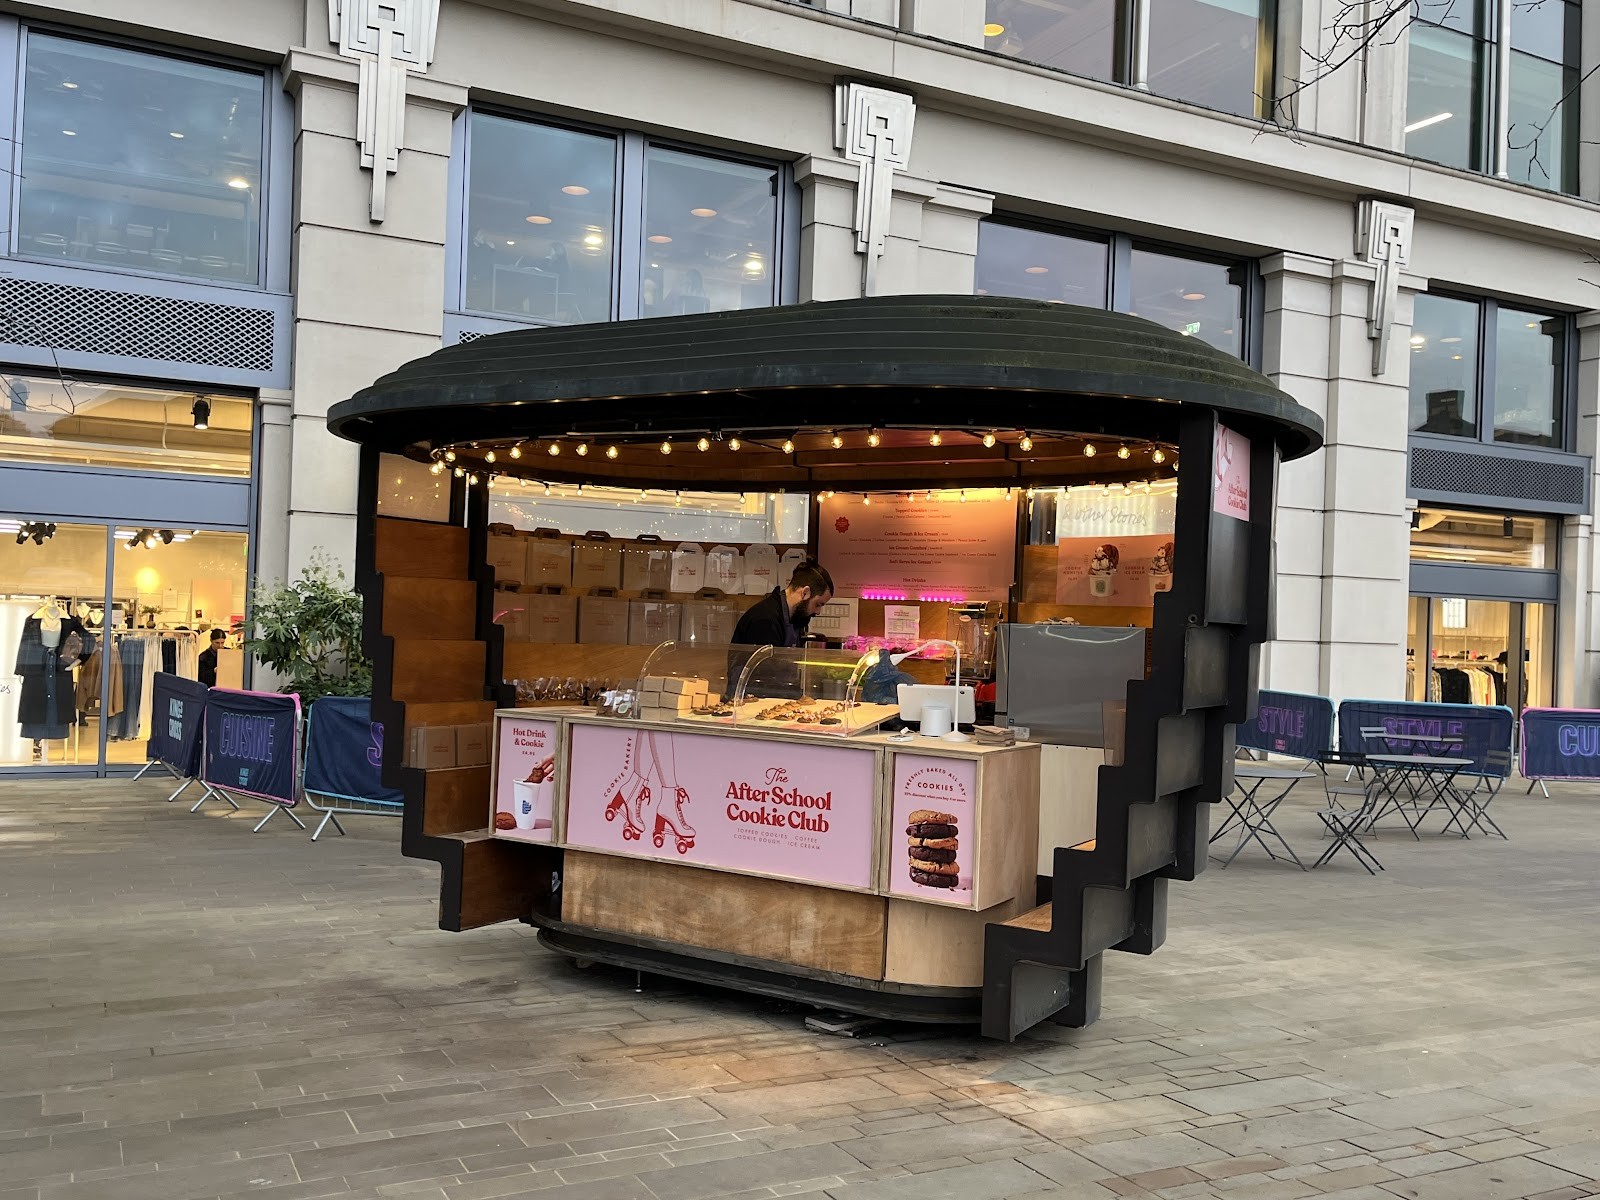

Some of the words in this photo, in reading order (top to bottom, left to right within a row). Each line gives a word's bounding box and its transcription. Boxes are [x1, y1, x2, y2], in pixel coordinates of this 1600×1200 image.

[168, 718, 182, 741] CROSS
[513, 728, 526, 737] Hot
[526, 729, 546, 738] Drink
[1258, 706, 1304, 738] STYLE
[1382, 717, 1462, 750] STYLE
[220, 711, 276, 764] CUISINE
[520, 739, 544, 748] Cookie
[604, 772, 624, 798] COOKIE
[624, 737, 632, 770] BAKERY
[765, 768, 788, 786] The
[948, 772, 958, 782] ALL
[726, 782, 770, 802] After
[772, 786, 832, 810] School
[918, 782, 954, 792] COOKIES
[726, 804, 786, 827] Cookie
[788, 810, 829, 832] Club
[734, 834, 756, 842] COOKIE
